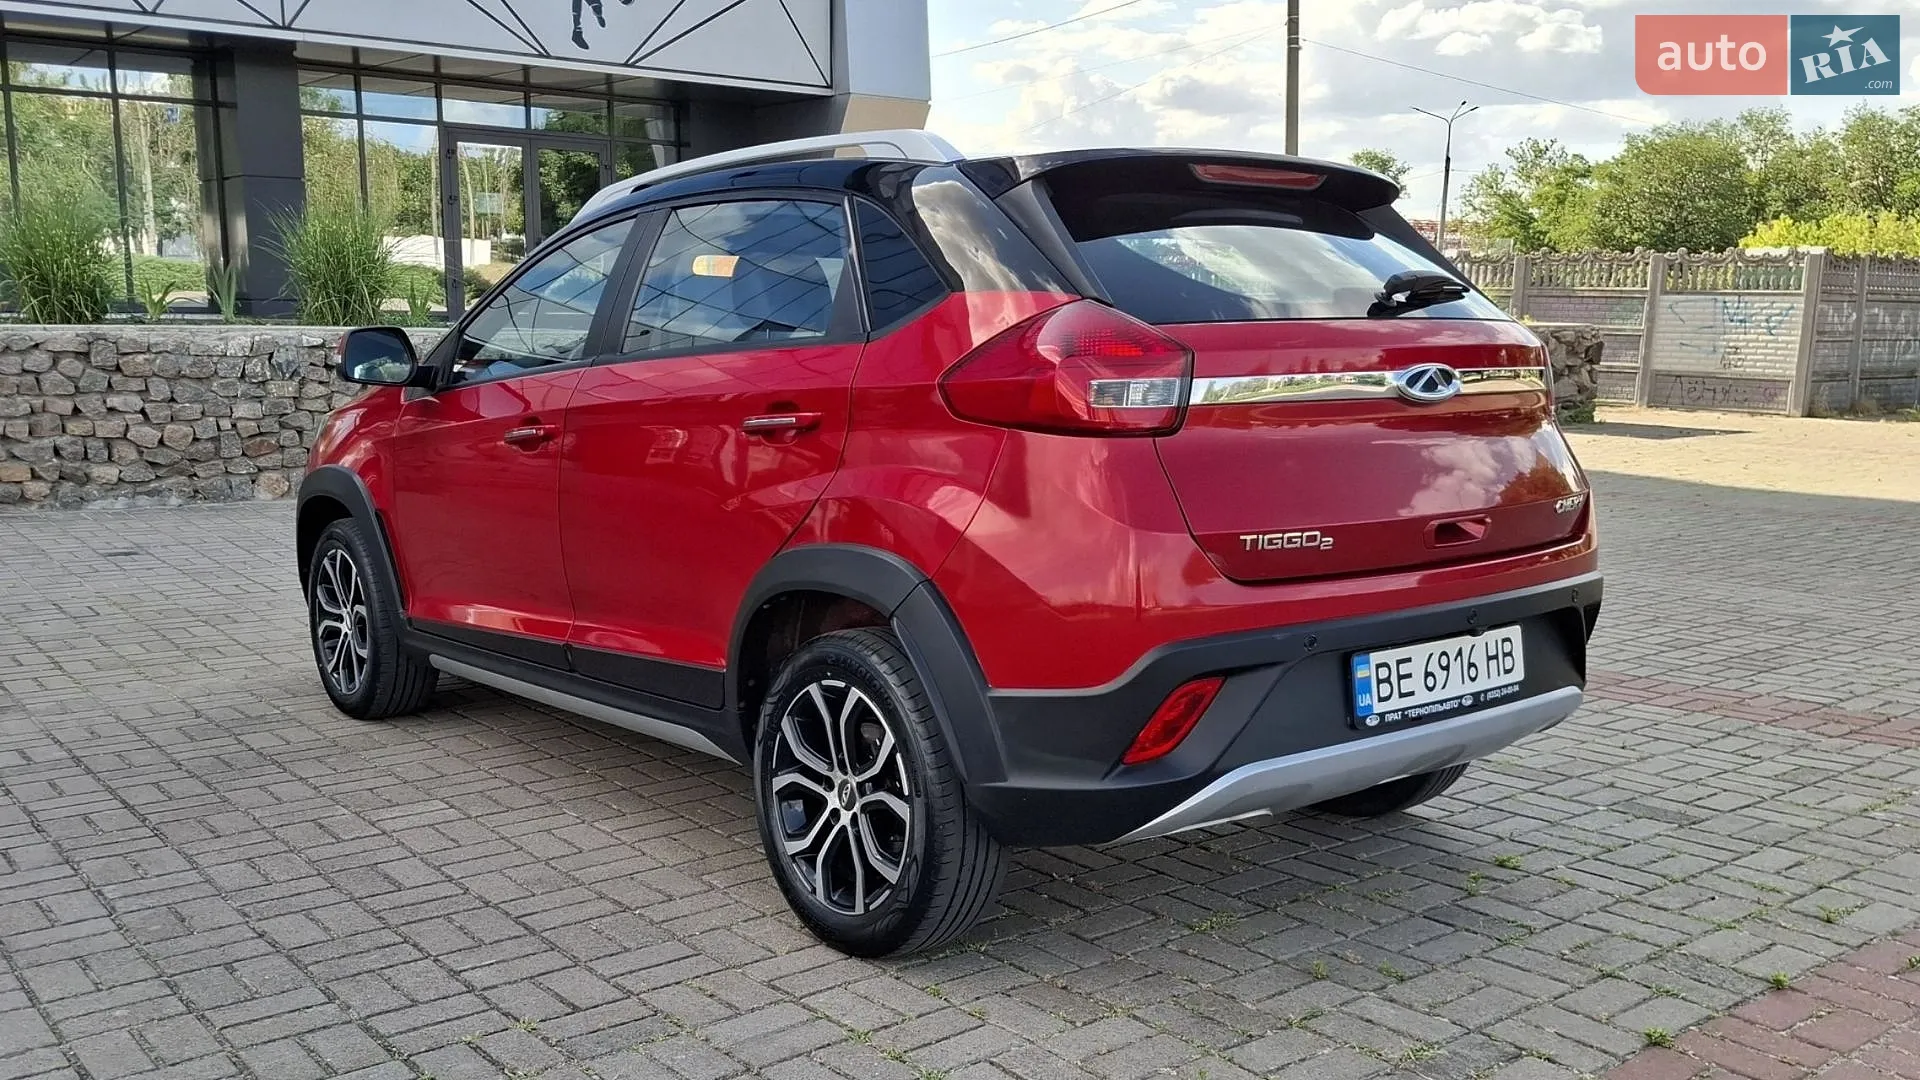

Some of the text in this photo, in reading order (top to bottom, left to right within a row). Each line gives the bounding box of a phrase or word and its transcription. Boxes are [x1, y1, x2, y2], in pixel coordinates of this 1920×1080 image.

[1374, 636, 1515, 703] BE 6916 HB
[1358, 693, 1372, 707] UA
[1384, 711, 1402, 723] ПРАТ
